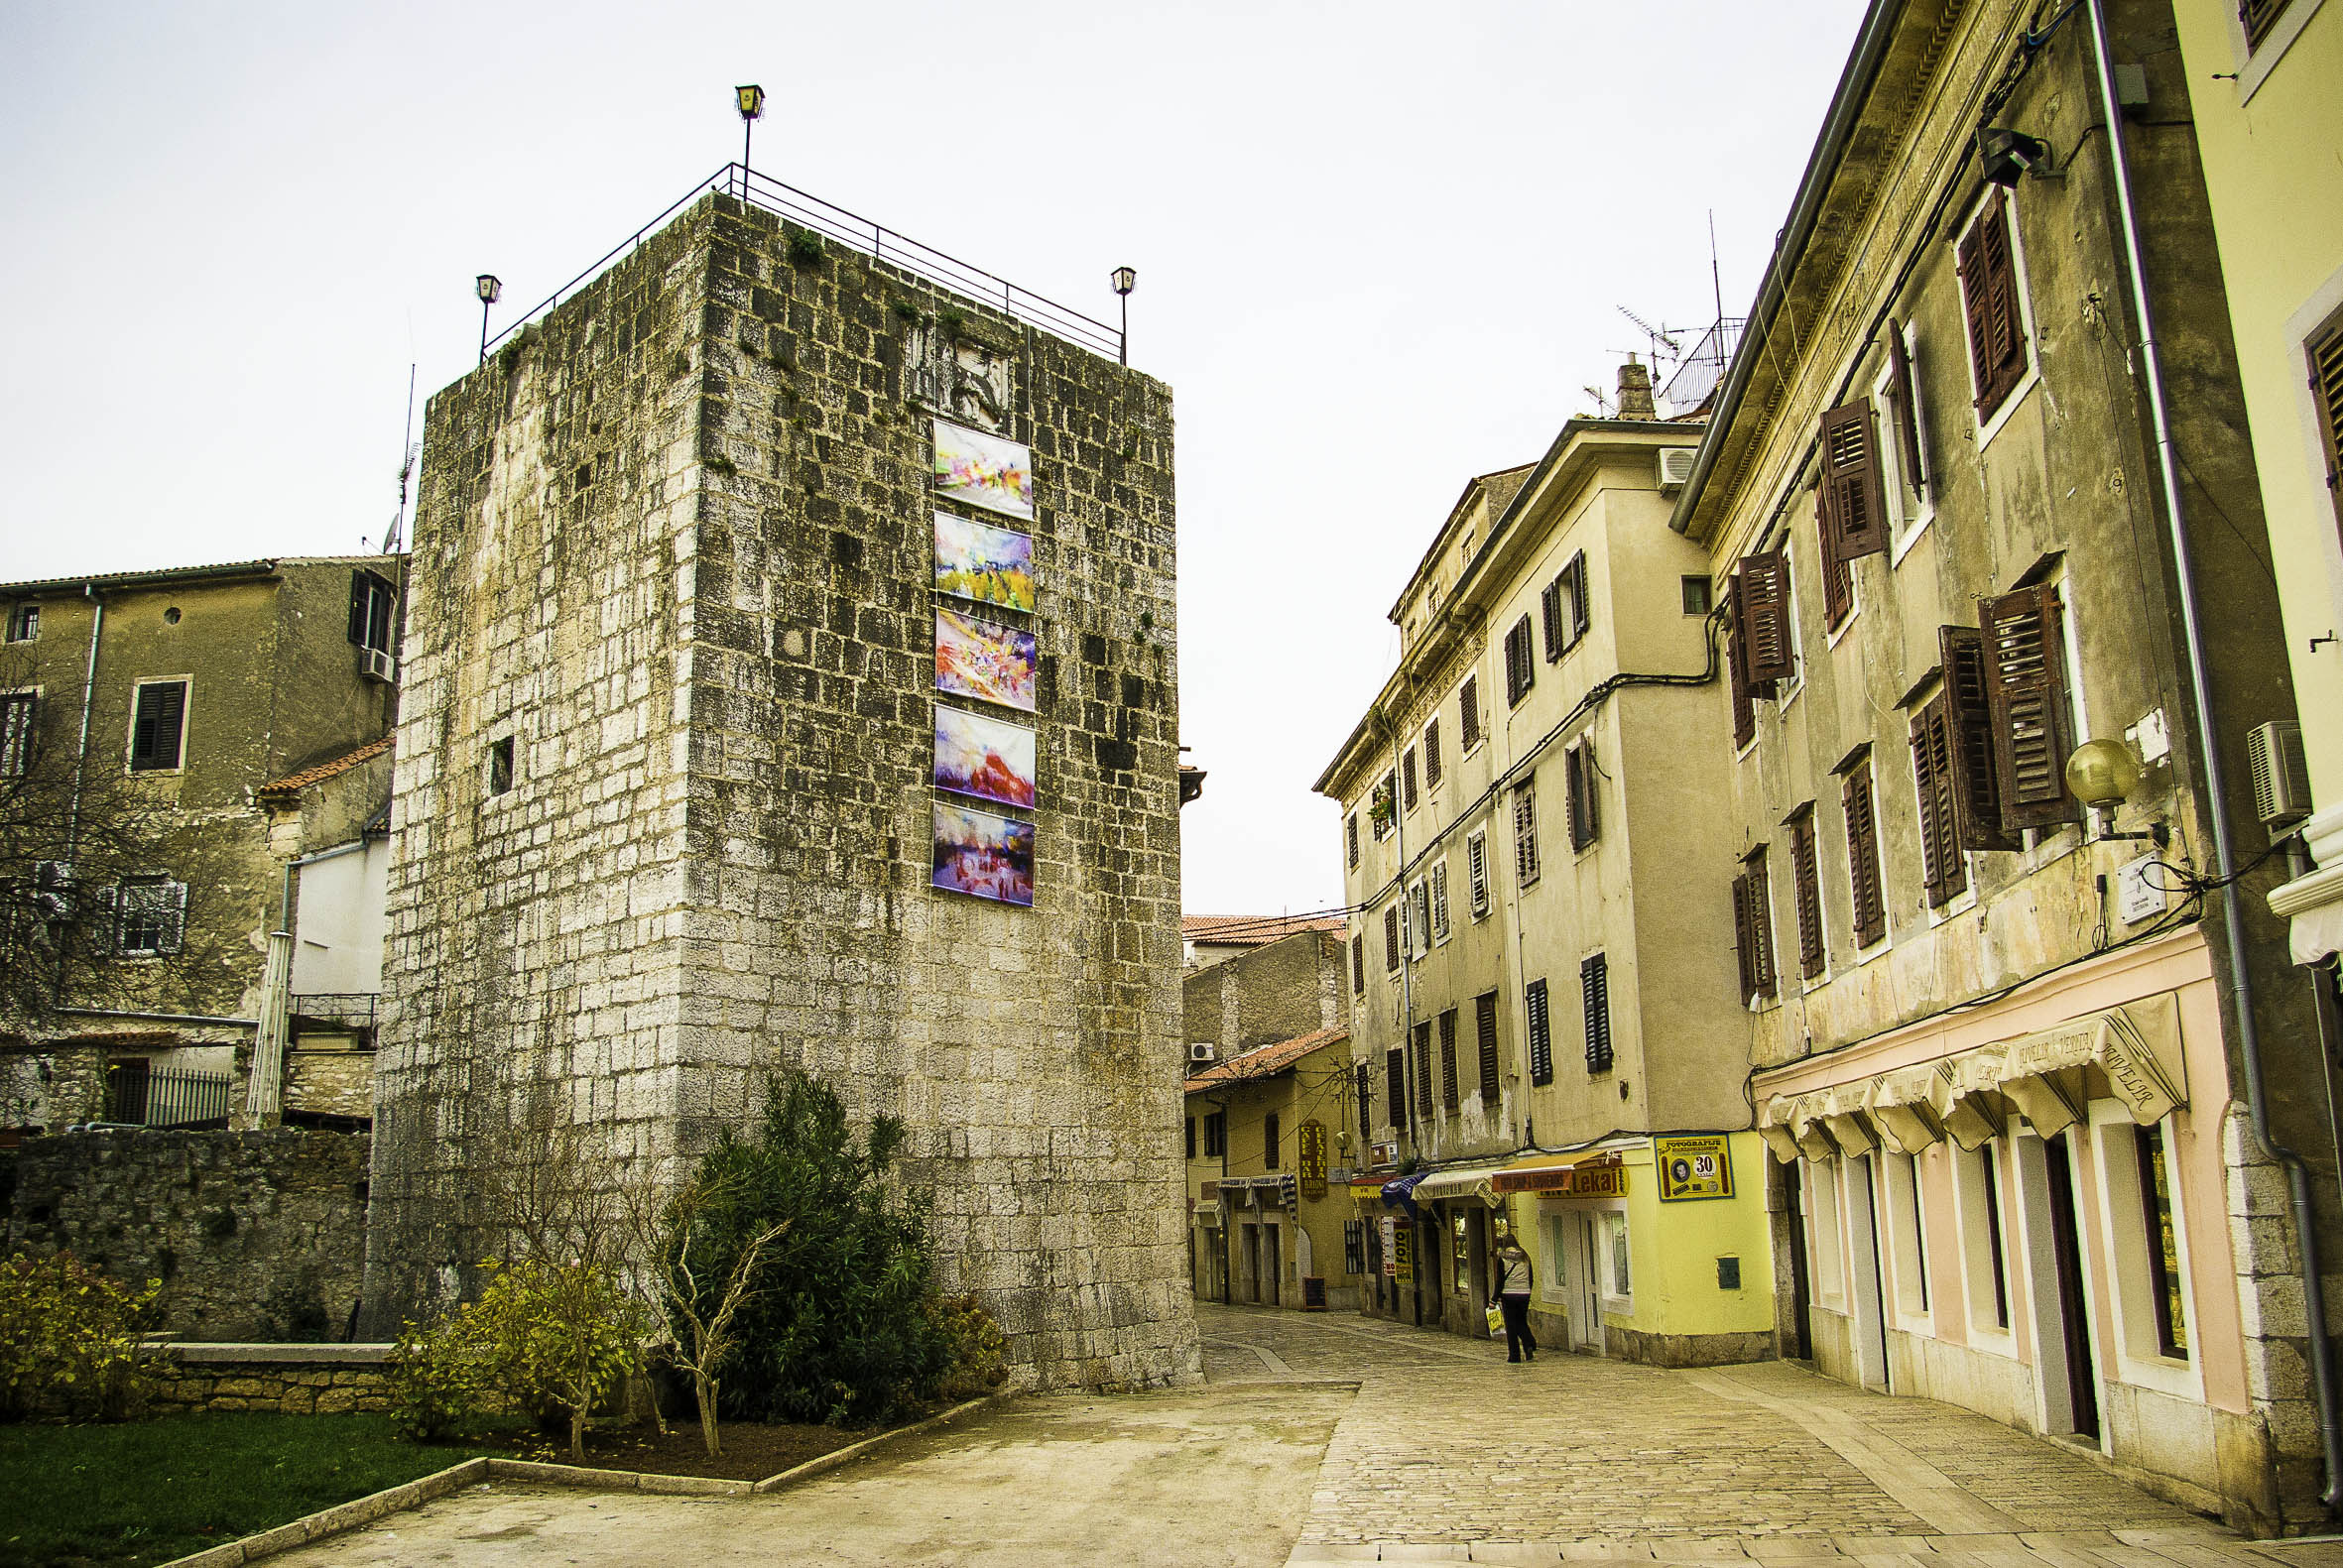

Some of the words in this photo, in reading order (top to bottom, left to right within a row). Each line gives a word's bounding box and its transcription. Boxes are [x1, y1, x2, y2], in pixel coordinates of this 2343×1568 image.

[2096, 1042, 2155, 1111] JUVELIR
[1695, 1155, 1713, 1173] 30
[1571, 1168, 1618, 1194] Lekaj
[1395, 1232, 1407, 1264] FOTO
